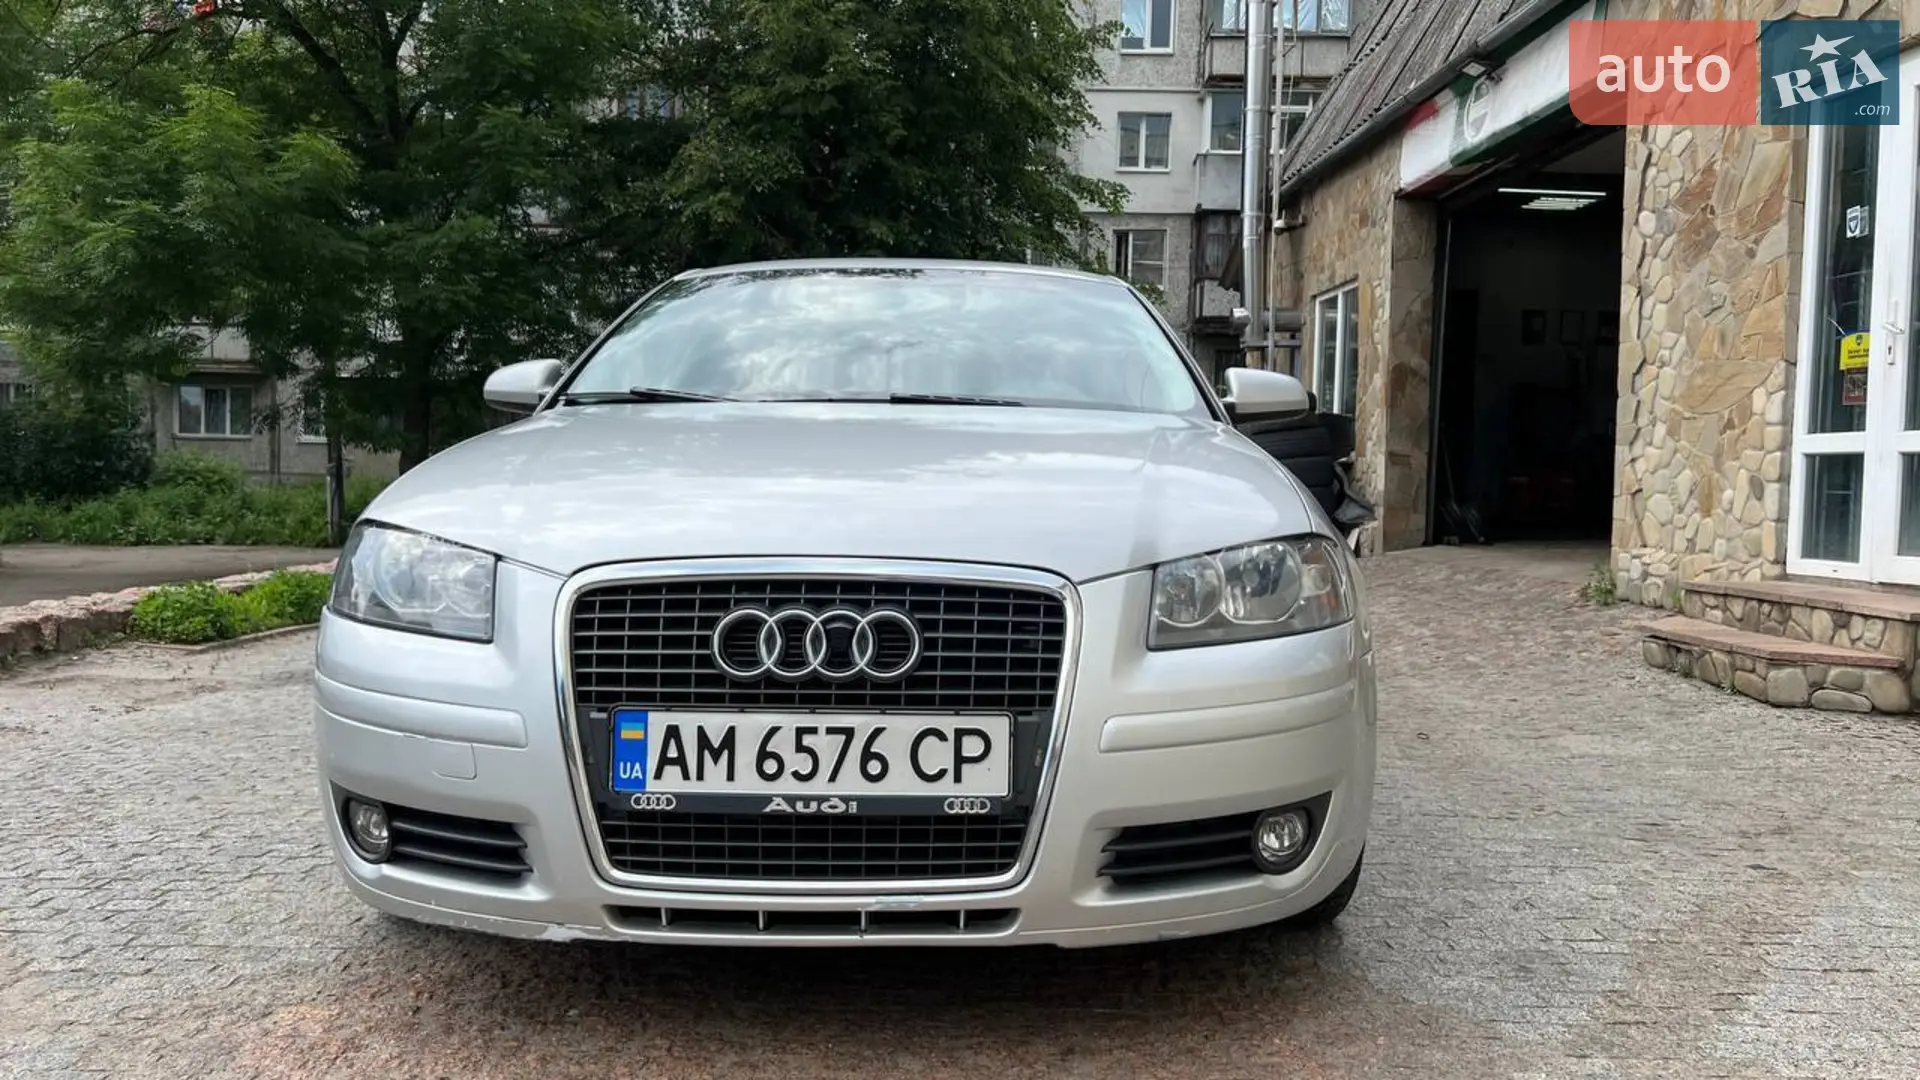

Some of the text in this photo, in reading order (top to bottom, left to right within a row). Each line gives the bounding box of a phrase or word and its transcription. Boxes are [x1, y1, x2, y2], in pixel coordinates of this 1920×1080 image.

[653, 724, 992, 783] AM 6576 CP
[619, 761, 643, 779] UA
[761, 796, 858, 814] Audi
